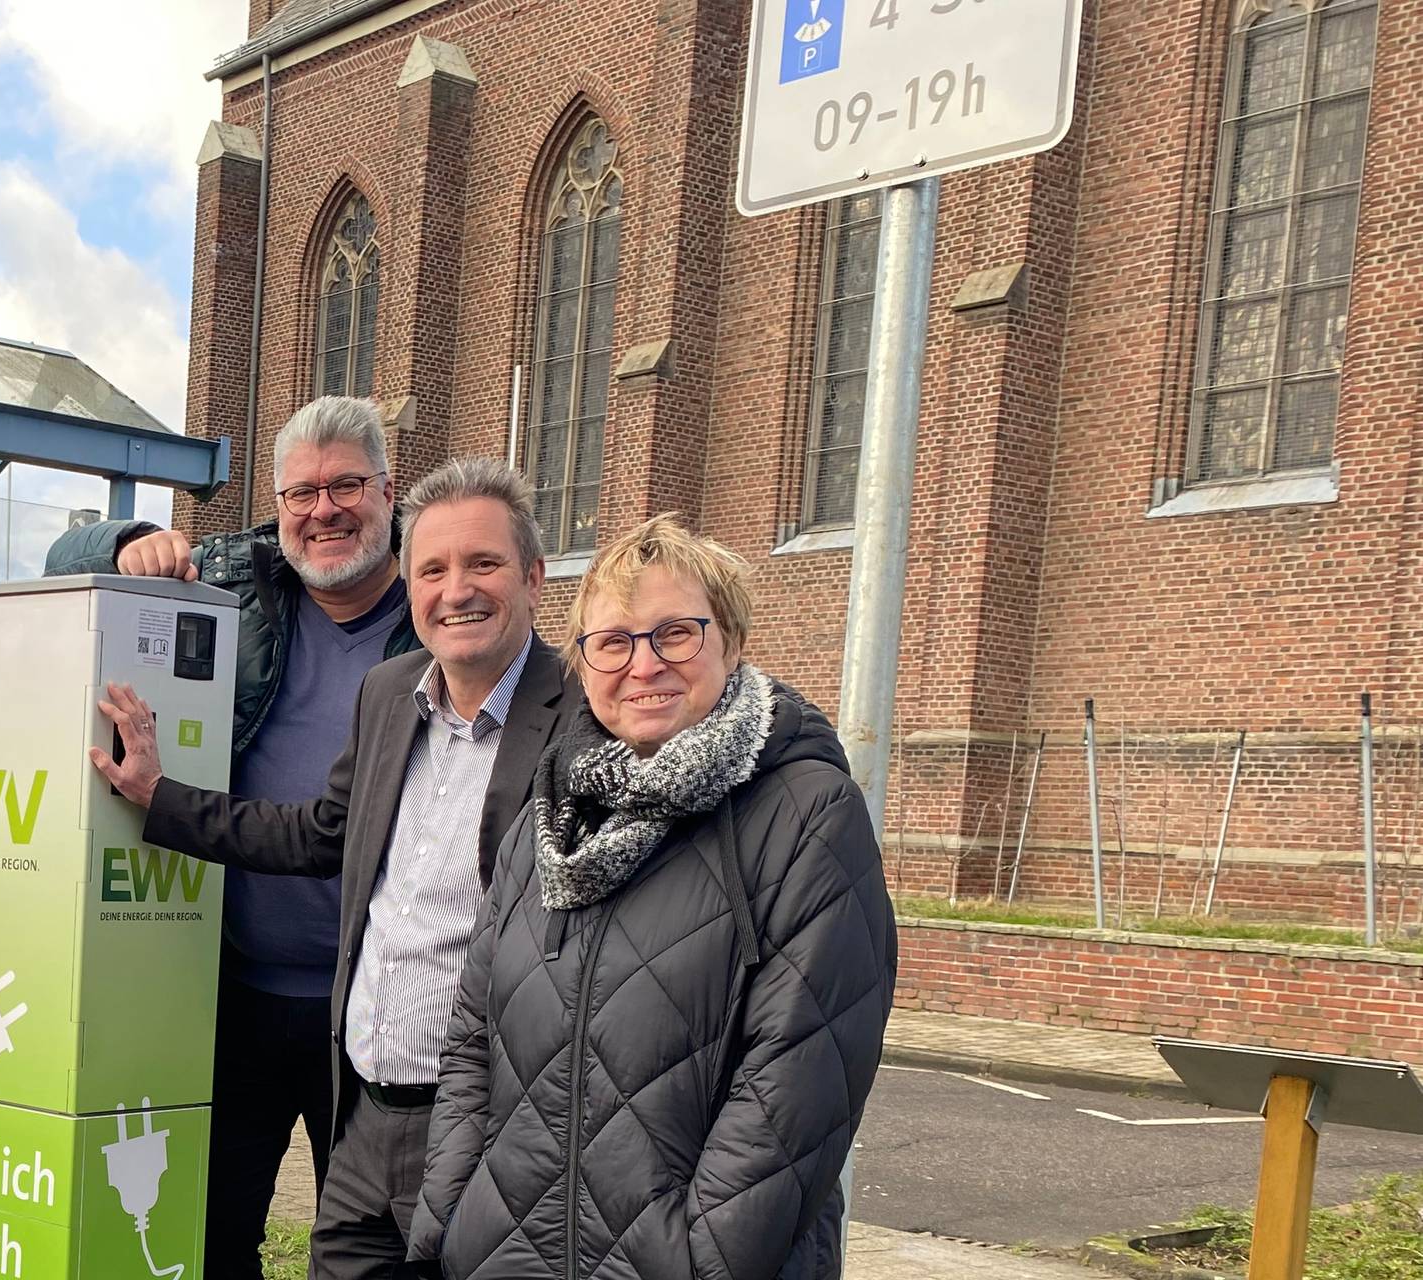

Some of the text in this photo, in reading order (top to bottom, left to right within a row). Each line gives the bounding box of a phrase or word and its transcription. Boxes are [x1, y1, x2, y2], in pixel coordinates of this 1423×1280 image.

[803, 47, 817, 68] P
[814, 62, 986, 152] 09-19h
[1, 858, 40, 872] REGION.
[102, 848, 207, 902] EWV
[100, 912, 204, 921] DEINE ENERGIE. DEINE REGION.
